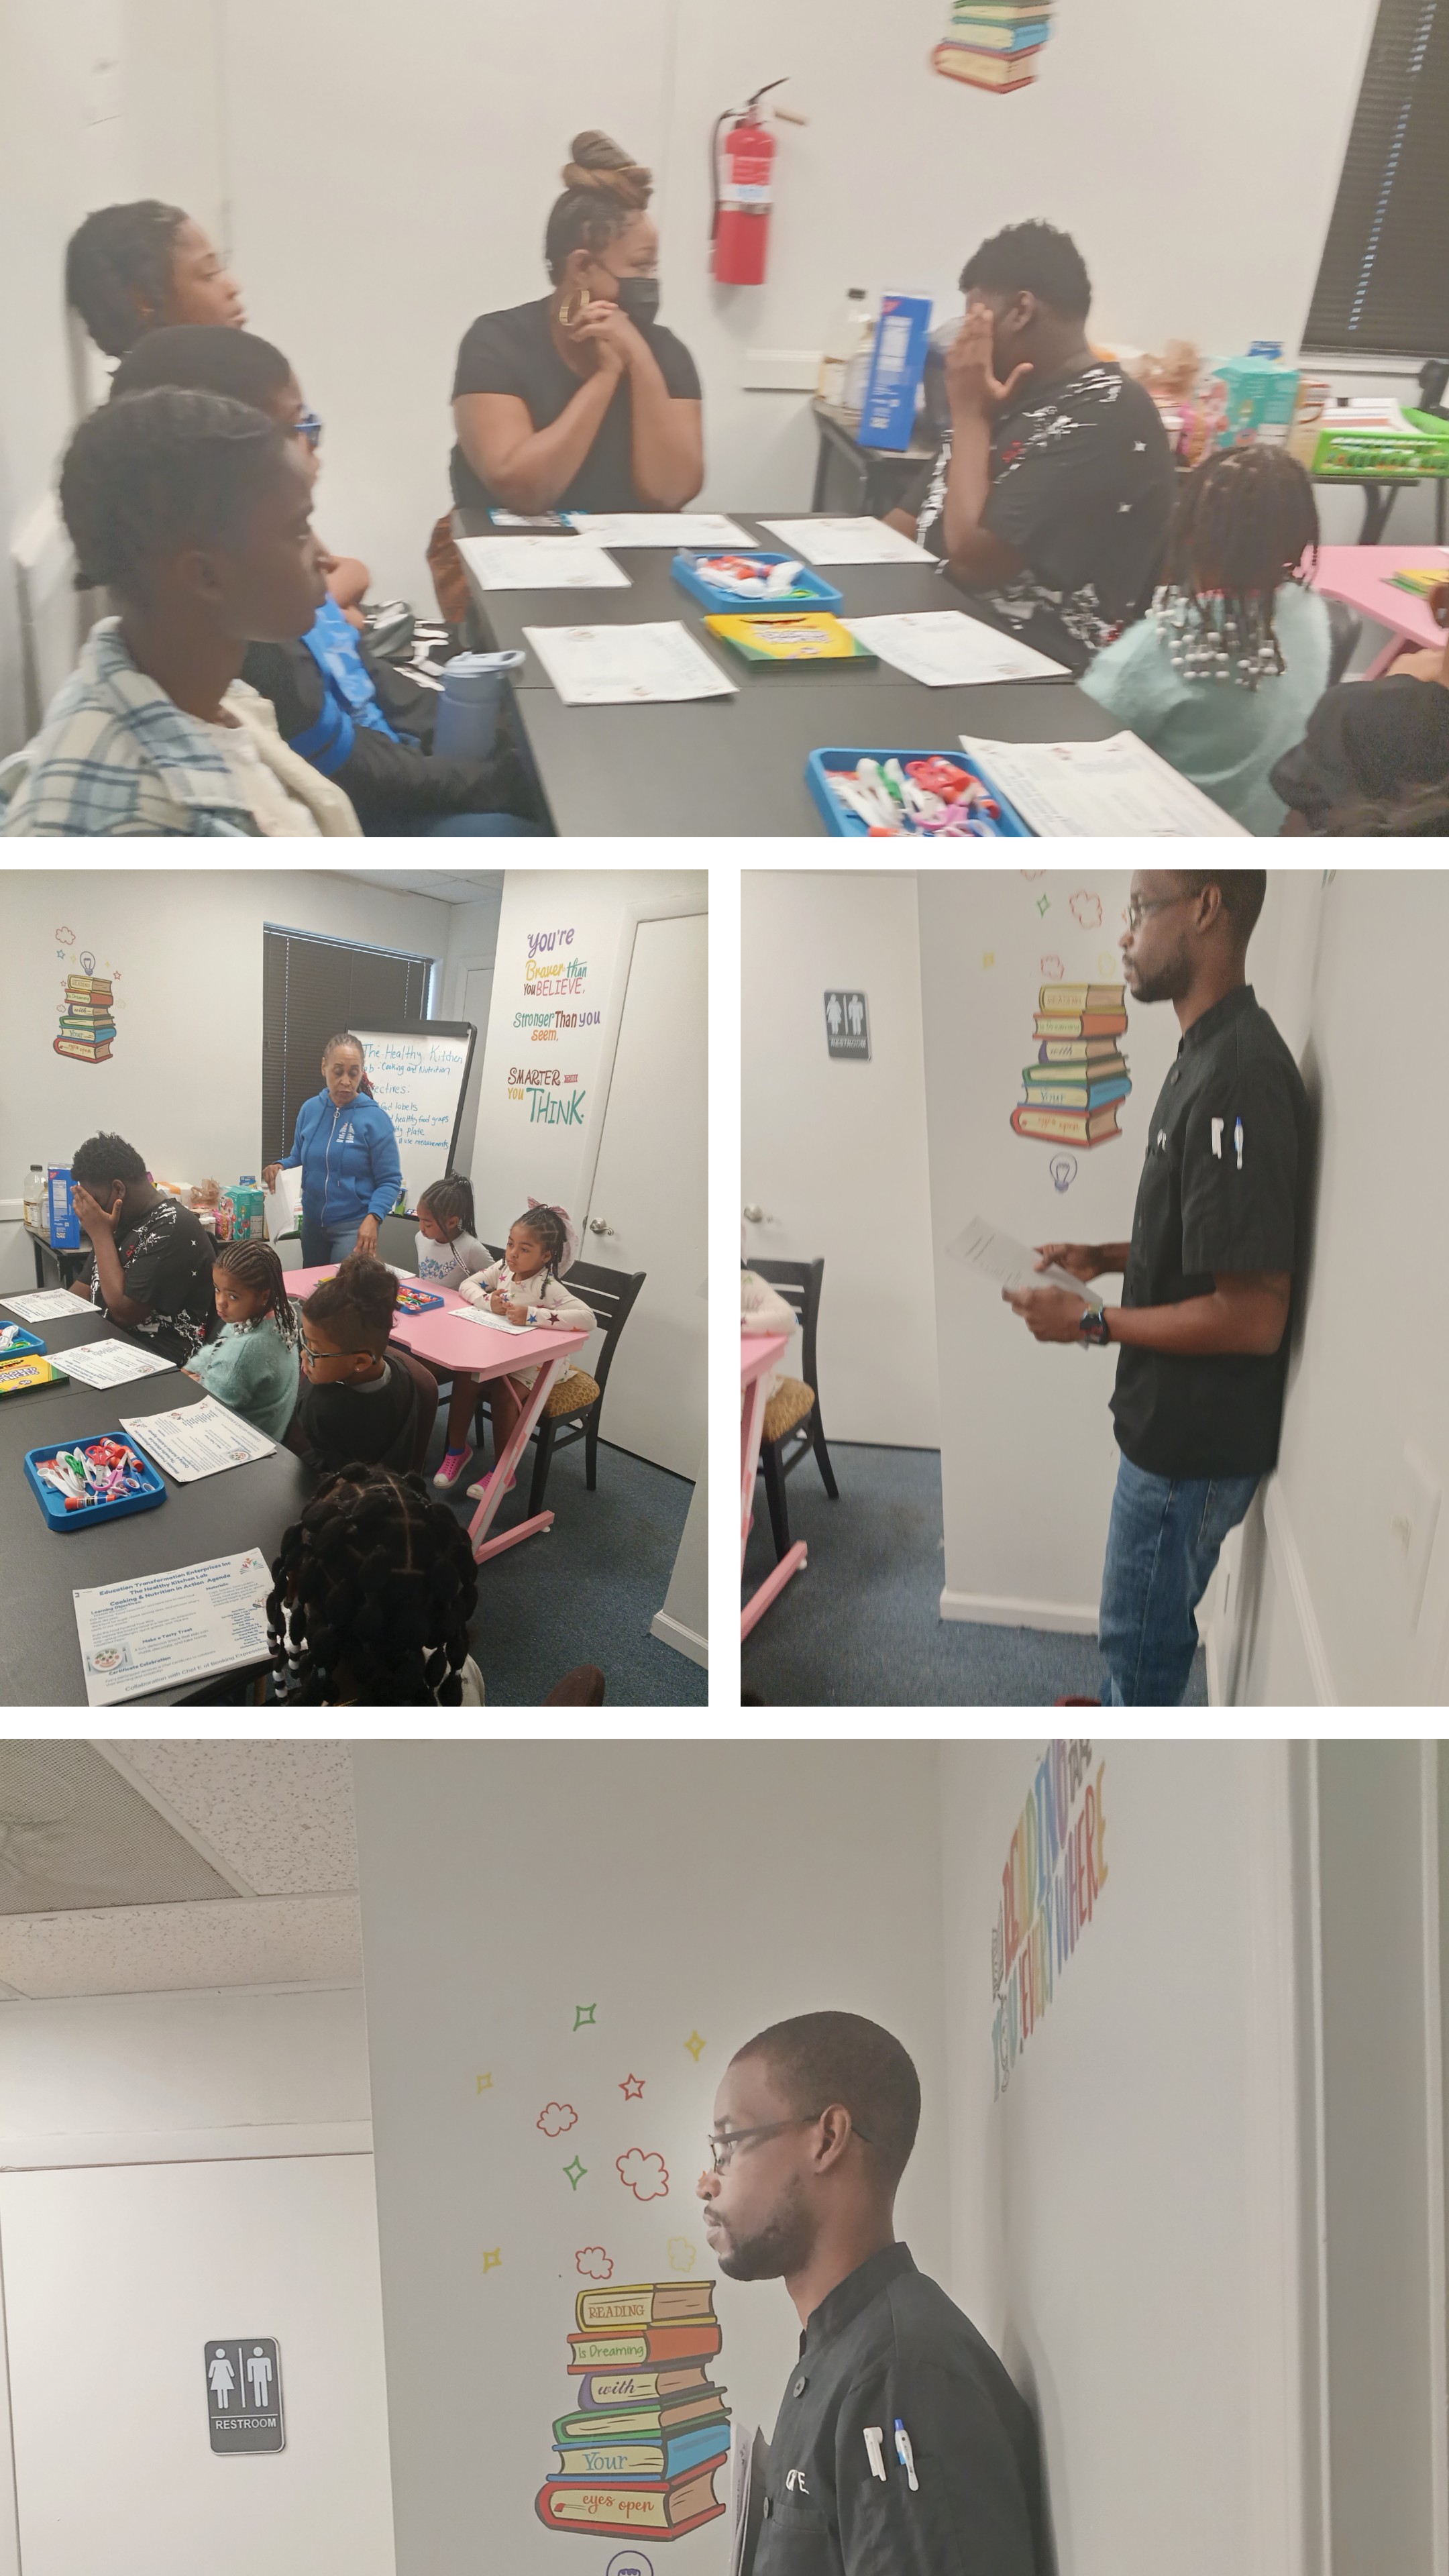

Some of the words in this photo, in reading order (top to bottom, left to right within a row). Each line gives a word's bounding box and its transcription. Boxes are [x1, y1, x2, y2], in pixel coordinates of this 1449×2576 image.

[526, 959, 566, 981] Braver
[566, 958, 587, 978] than
[513, 1012, 555, 1028] Stronger
[555, 1011, 577, 1028] Than
[579, 1011, 600, 1027] you
[69, 1030, 84, 1038] Your
[363, 1044, 379, 1058] The
[385, 1043, 422, 1066] Healthy
[430, 1044, 462, 1063] Kitchen
[1050, 1044, 1073, 1056] with
[382, 1063, 404, 1075] Cooking
[419, 1065, 450, 1075] Nutrition
[508, 1067, 560, 1085] SMARTER
[1040, 1089, 1066, 1104] Your
[396, 1102, 418, 1111] labels
[526, 1087, 586, 1125] THINK.
[395, 1114, 417, 1126] healthy
[99, 1584, 133, 1596] Education
[134, 1572, 184, 1588] Transformation
[186, 1563, 221, 1576] Enterprises
[144, 1581, 170, 1593] Healthy
[170, 1576, 195, 1585] Kitchen
[109, 1595, 138, 1607] Cooking
[144, 1587, 174, 1598] Nutrition
[182, 1579, 204, 1589] Action
[207, 1573, 231, 1583] Agenda
[162, 1631, 178, 1640] Tasty
[108, 1664, 138, 1676] Certificate
[139, 1655, 171, 1668] Celebration
[125, 1676, 166, 1692] Collaboration
[168, 1671, 180, 1679] with
[588, 2305, 645, 2318] READING
[578, 2345, 587, 2359] Is
[590, 2345, 644, 2357] Dreaming
[598, 2379, 635, 2395] with
[216, 2418, 276, 2430] RESTROOM
[582, 2453, 628, 2471] Your
[583, 2495, 615, 2514] eyes
[619, 2500, 654, 2519] open
